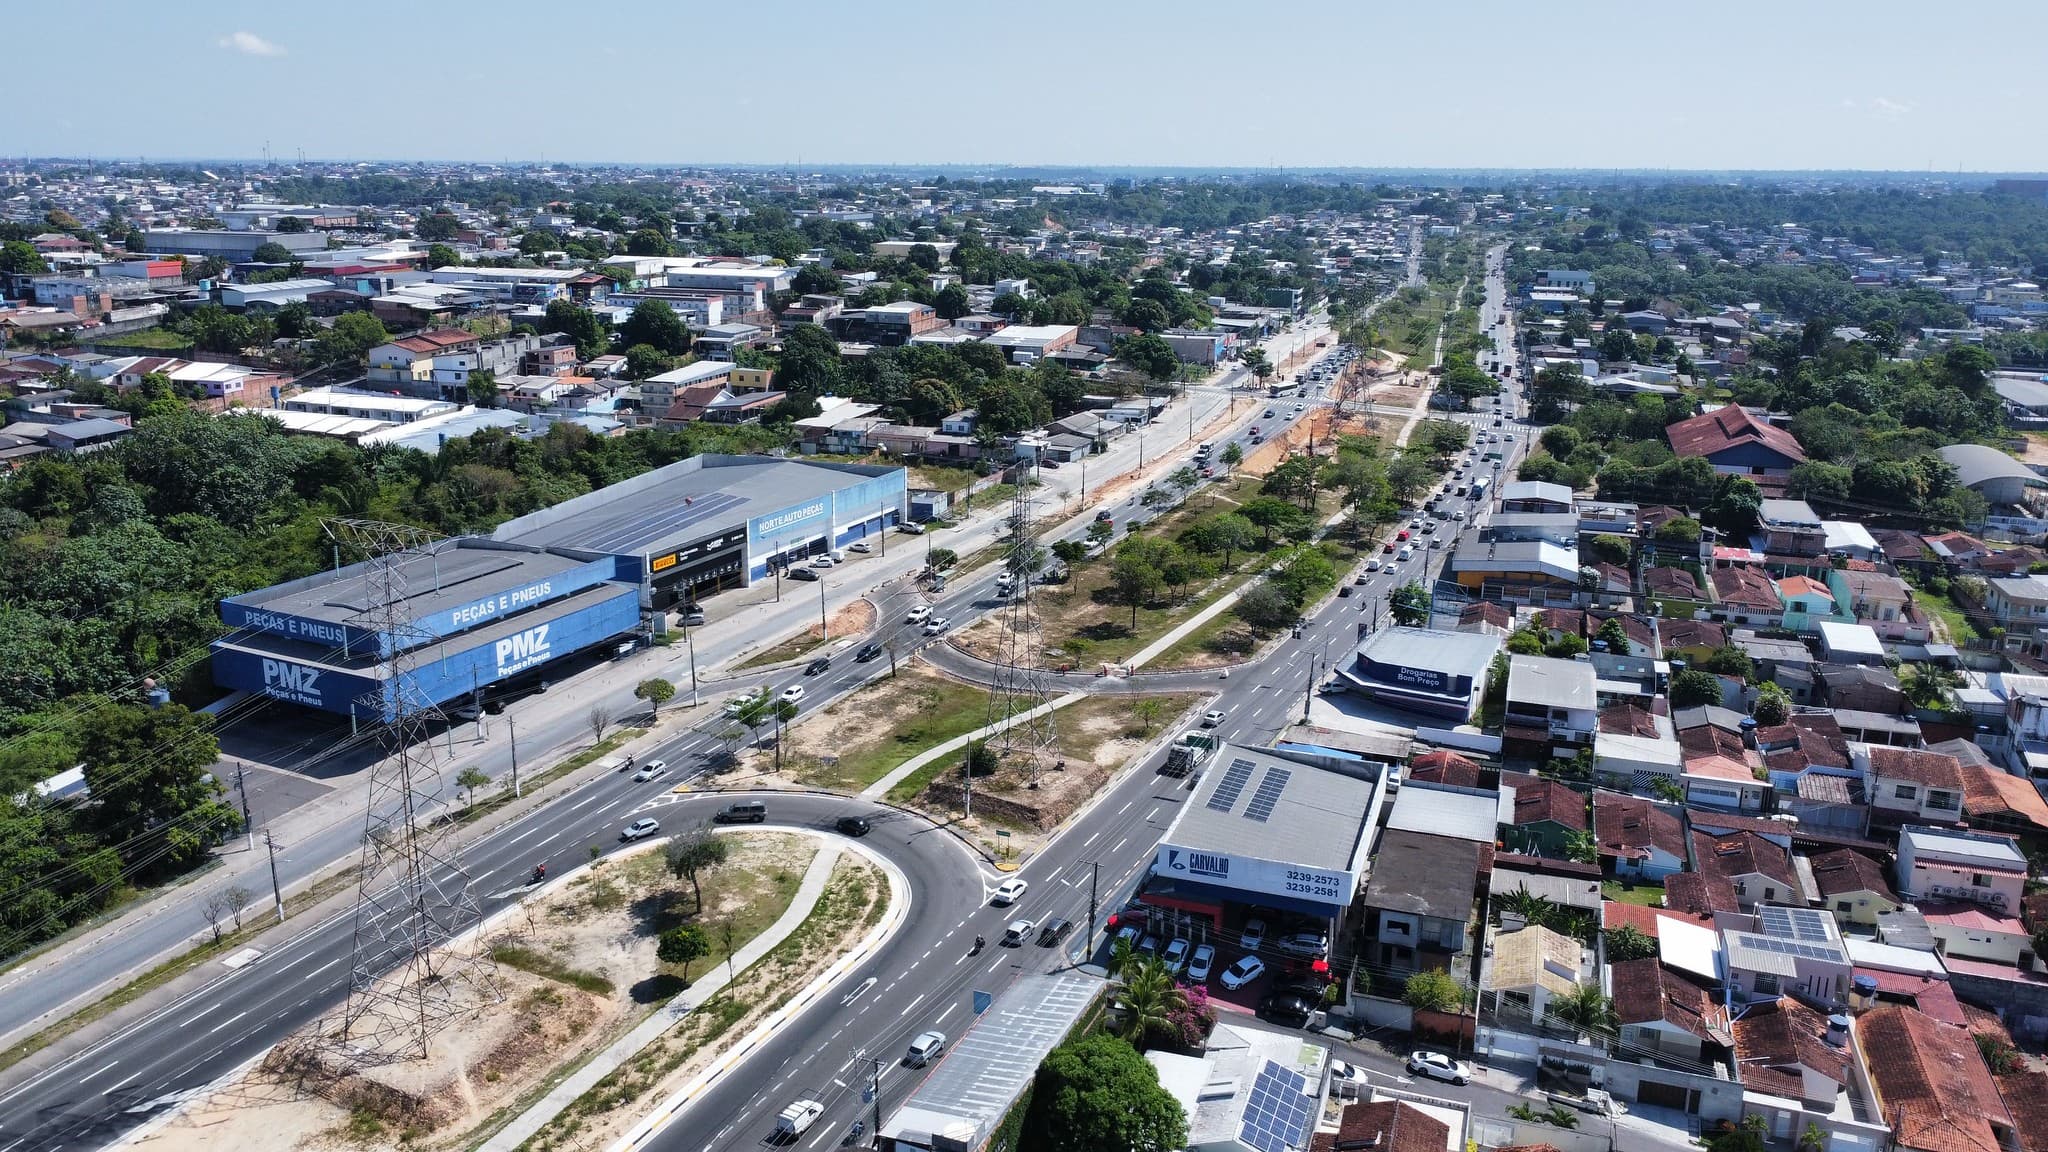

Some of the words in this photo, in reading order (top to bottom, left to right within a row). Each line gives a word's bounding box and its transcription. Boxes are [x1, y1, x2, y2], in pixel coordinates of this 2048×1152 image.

[760, 516, 783, 532] NORTE
[783, 510, 802, 524] AUTO
[453, 601, 495, 625] PEÇAS
[499, 596, 508, 610] E
[512, 582, 551, 606] PNEUS
[245, 611, 285, 631] PEÇAS
[289, 619, 298, 634] E
[300, 622, 344, 642] PNEUS
[496, 624, 550, 667] PMZ
[263, 658, 322, 696] PMZ
[1397, 673, 1415, 682] Bom
[1416, 676, 1440, 687] Preço
[1401, 667, 1438, 680] Drogarias
[298, 693, 323, 706] Pneus
[1189, 853, 1229, 874] CARVALHO
[1286, 870, 1340, 887] 3239-2573
[1285, 882, 1339, 898] 3239-2581
